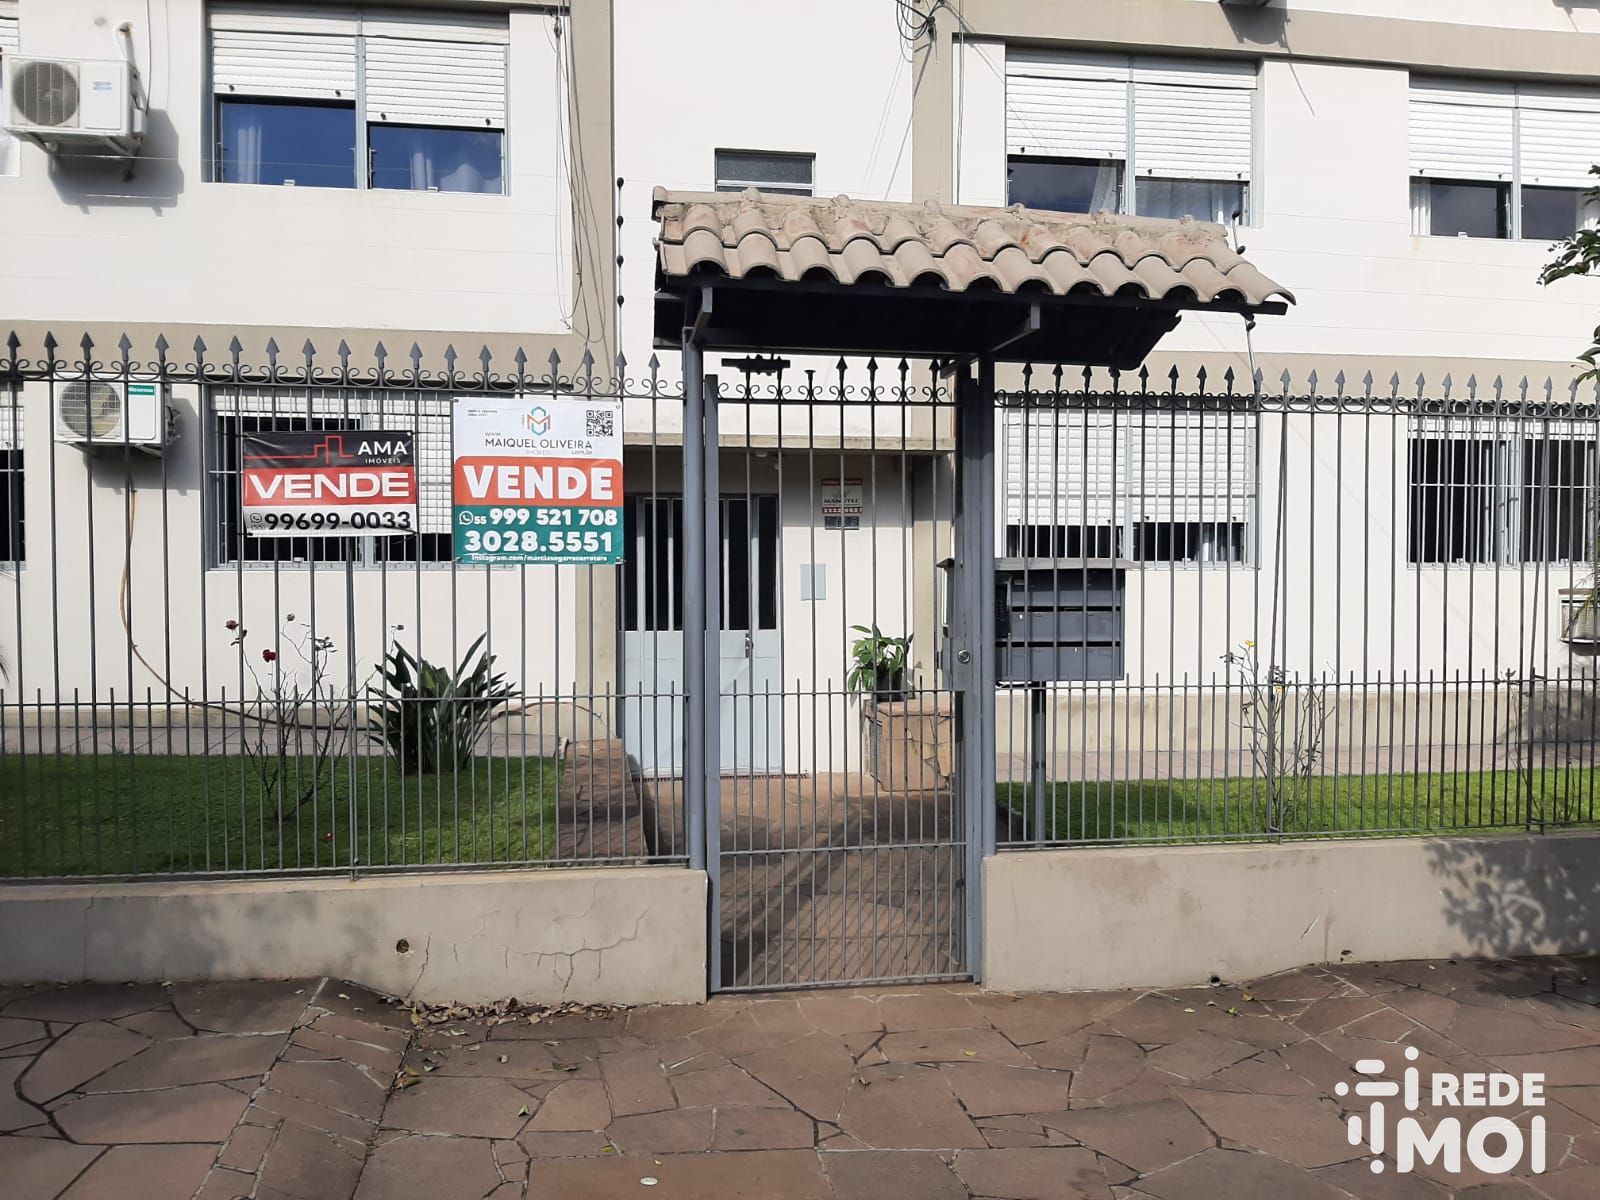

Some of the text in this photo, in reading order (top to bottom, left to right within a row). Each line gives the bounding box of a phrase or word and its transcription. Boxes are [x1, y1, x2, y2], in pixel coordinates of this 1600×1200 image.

[358, 441, 408, 456] AMA
[485, 438, 593, 449] MAIQUEL OLIVEIRA
[250, 472, 410, 499] VENDE
[462, 465, 613, 500] VENDE
[264, 511, 411, 530] 99699-0033
[474, 508, 618, 526] 55 999 521 708
[464, 530, 612, 552] 3028.5551
